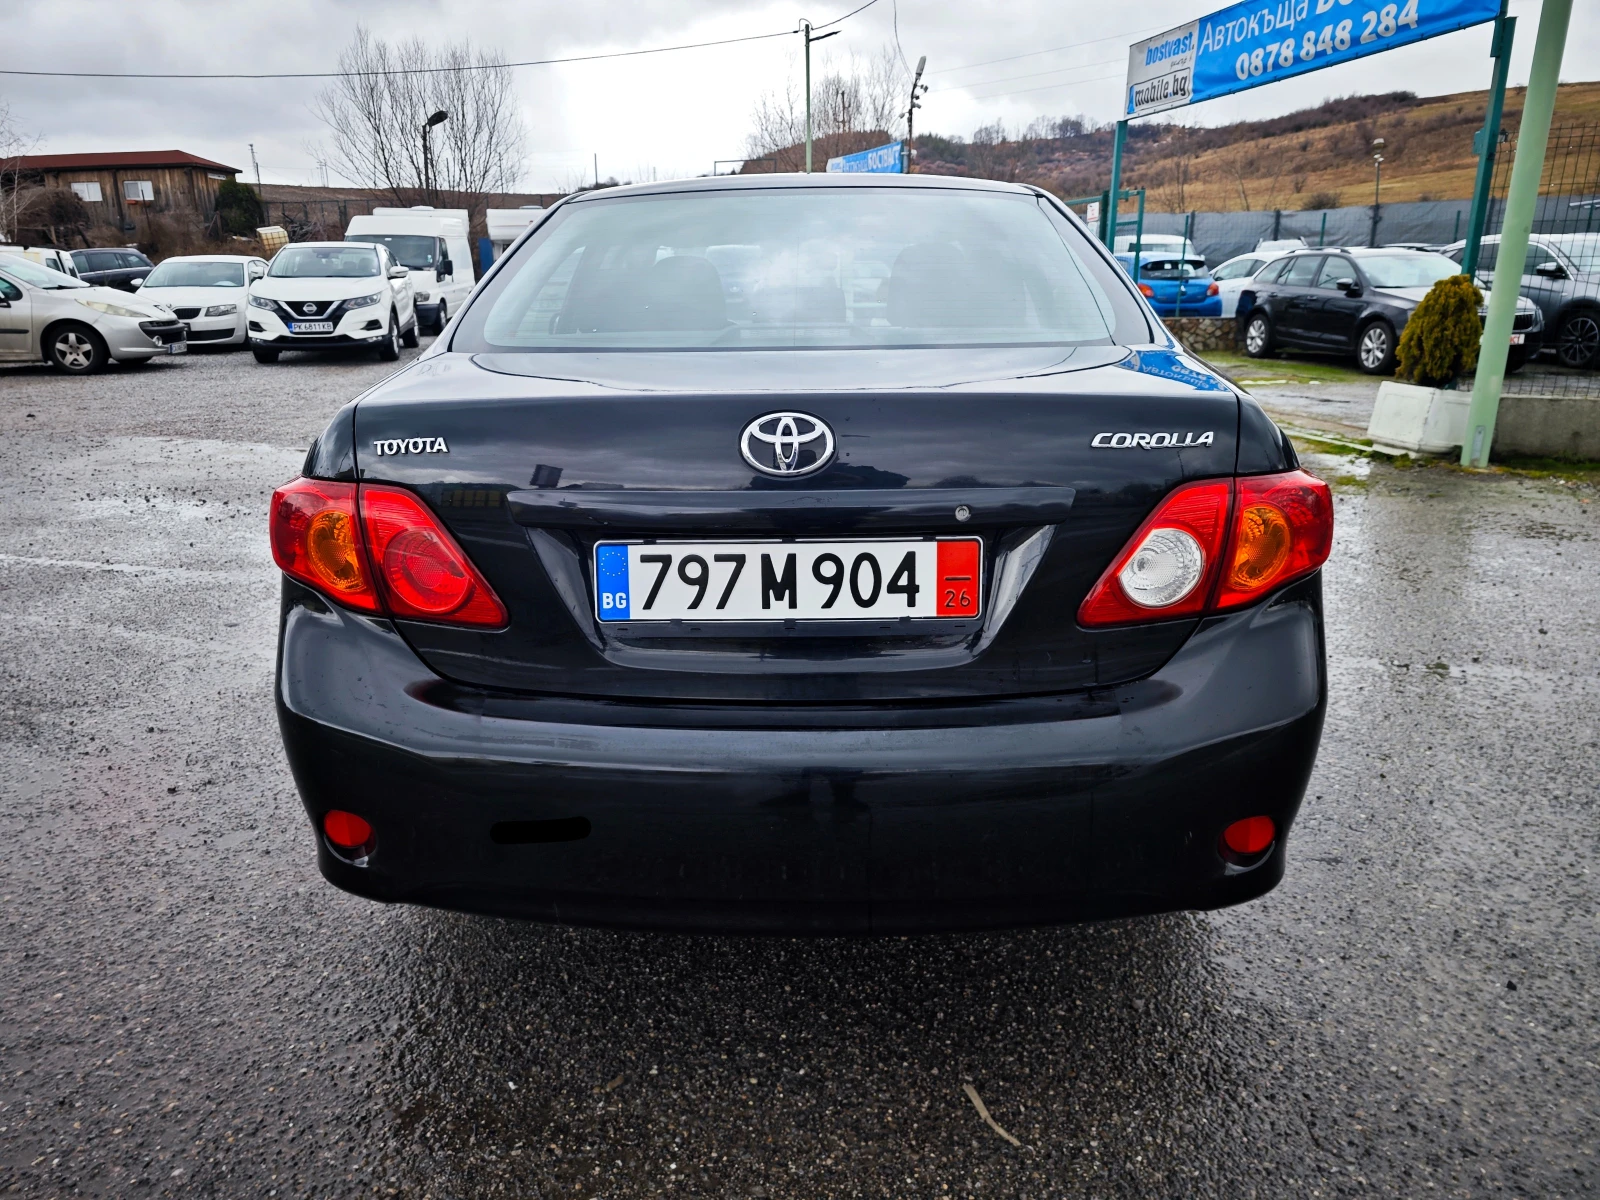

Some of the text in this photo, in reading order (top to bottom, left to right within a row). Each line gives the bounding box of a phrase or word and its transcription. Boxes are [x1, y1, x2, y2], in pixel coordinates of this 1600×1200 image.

[1236, 38, 1295, 80] 0878
[1300, 19, 1352, 61] 848
[1360, 0, 1418, 44] 284
[1134, 75, 1188, 107] mobile.bg
[373, 437, 449, 456] TOYOTA
[1091, 431, 1214, 450] COROLLA
[639, 551, 920, 610] 797 M 904
[602, 592, 627, 609] BG
[944, 588, 971, 608] 26
